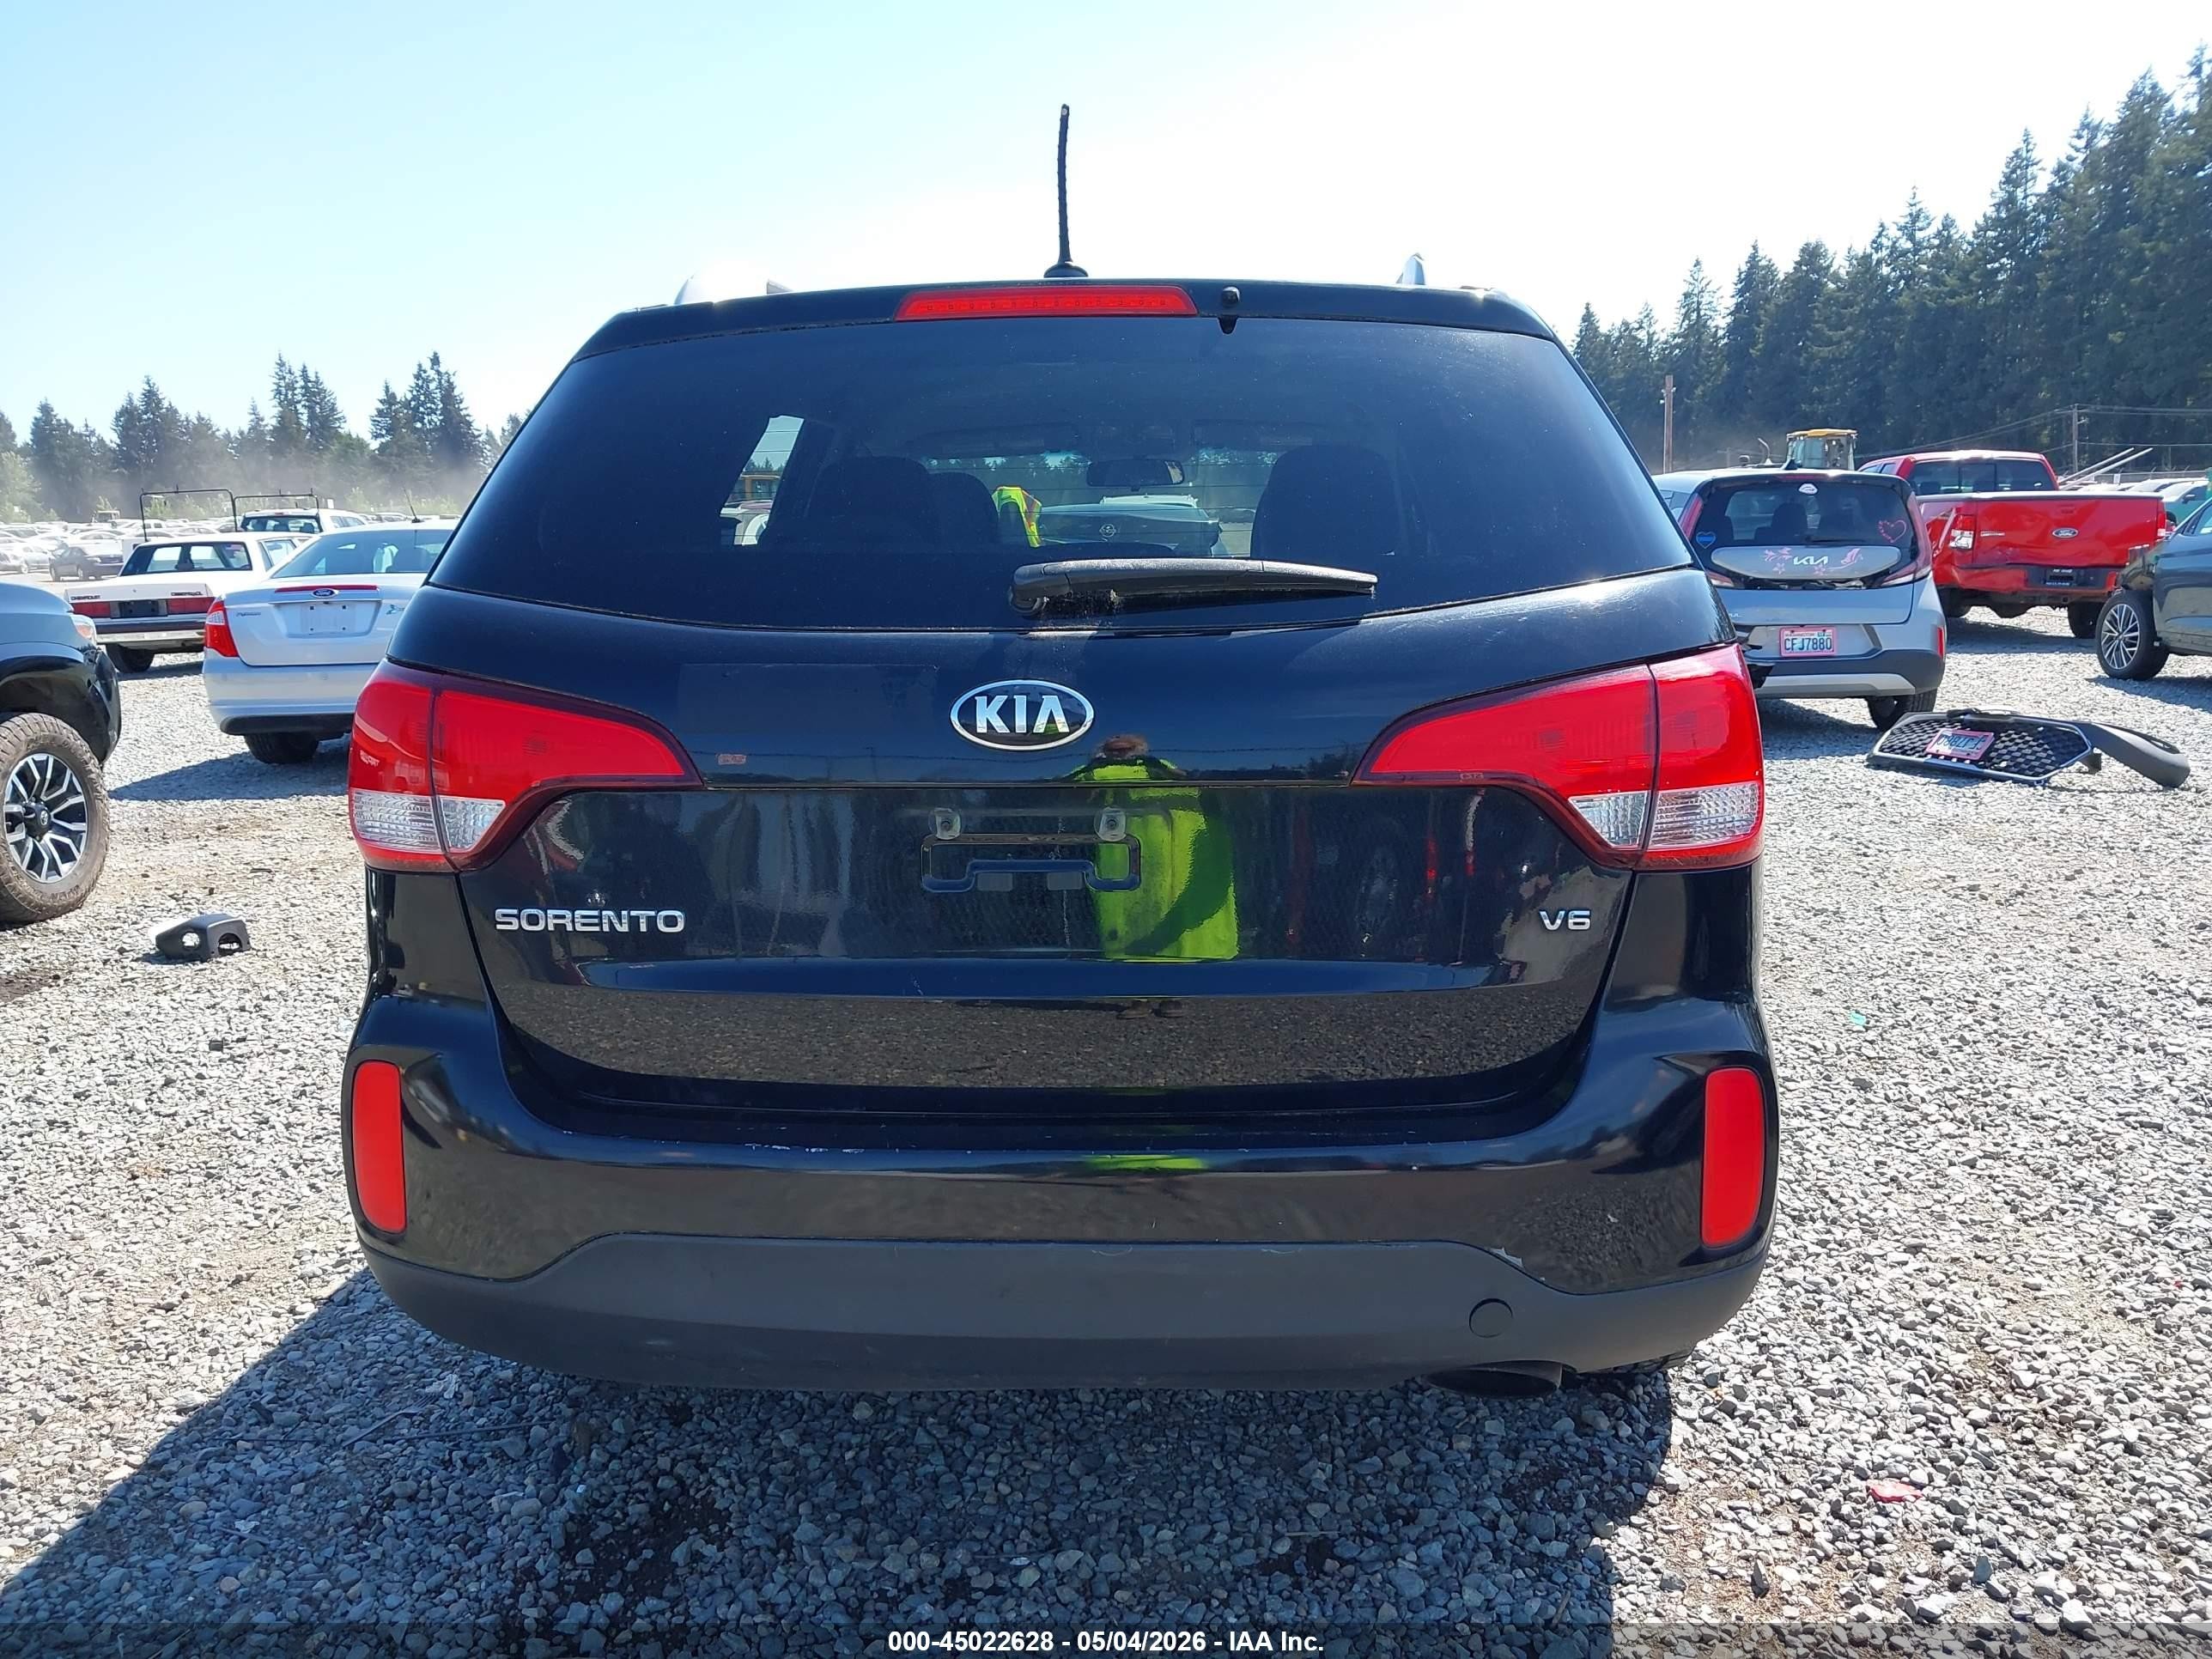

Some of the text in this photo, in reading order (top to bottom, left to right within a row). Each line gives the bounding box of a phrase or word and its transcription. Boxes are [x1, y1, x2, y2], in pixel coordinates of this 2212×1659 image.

[1784, 637, 1832, 651] CFJ7880
[975, 695, 1070, 733] KIA
[495, 908, 685, 933] SORENTO
[1539, 910, 1591, 931] V6
